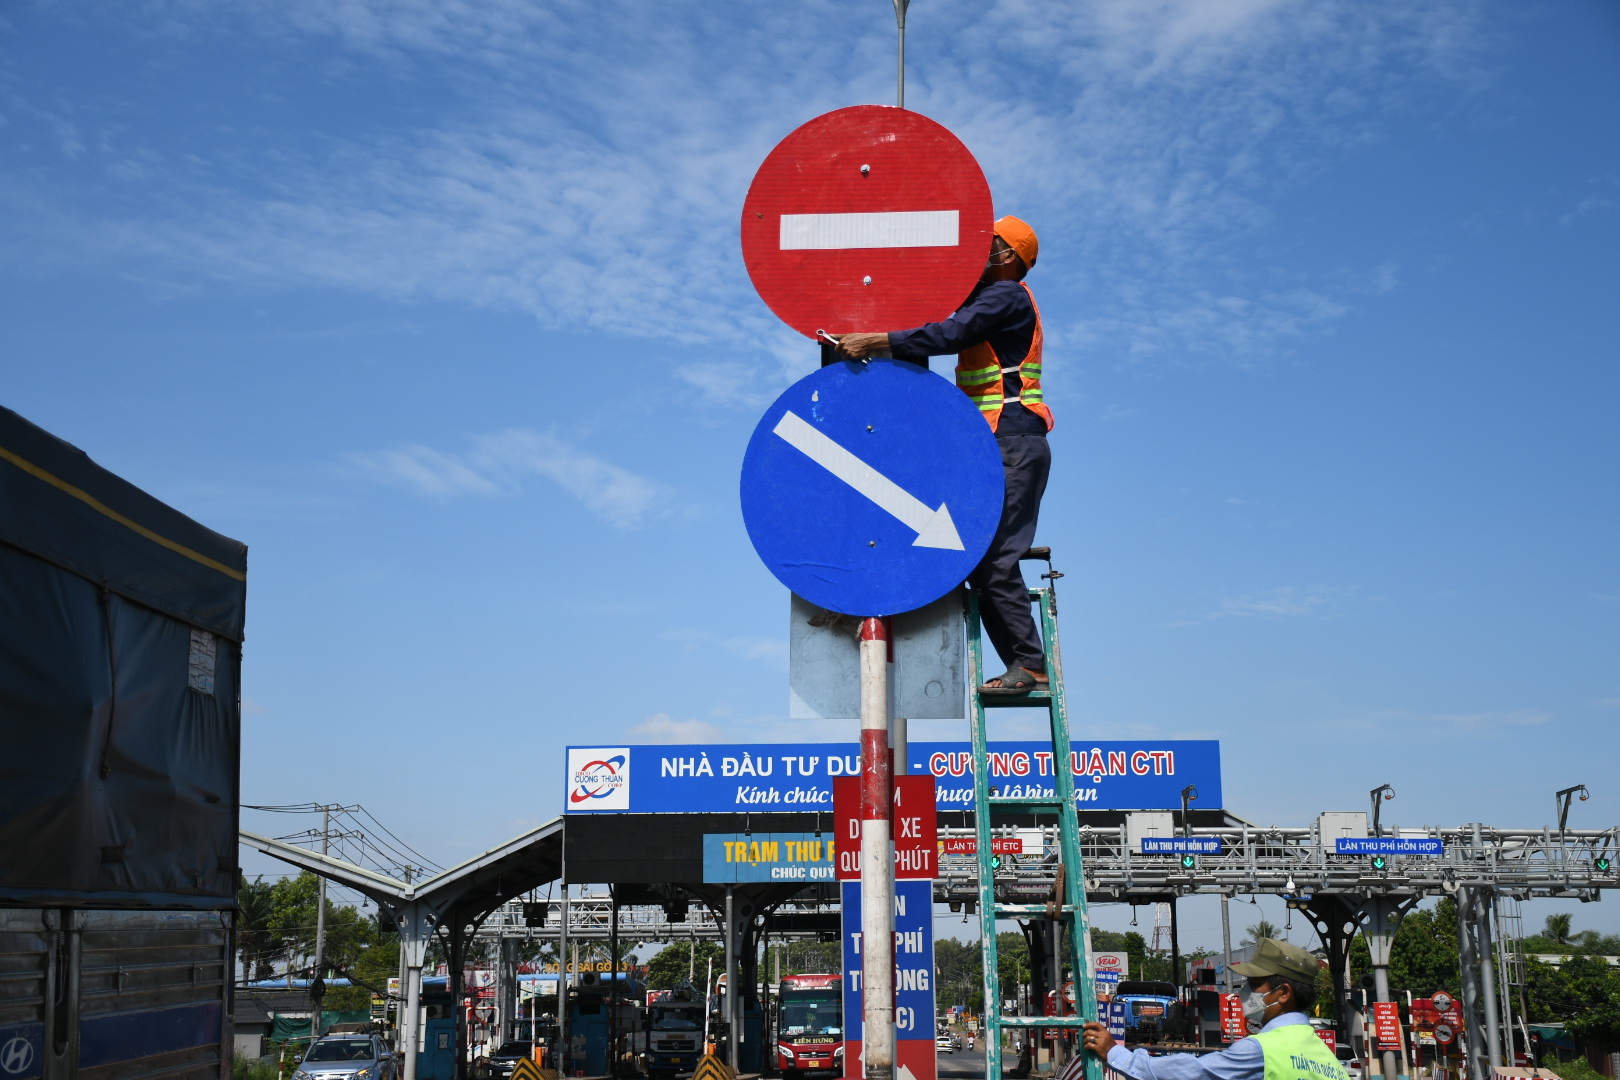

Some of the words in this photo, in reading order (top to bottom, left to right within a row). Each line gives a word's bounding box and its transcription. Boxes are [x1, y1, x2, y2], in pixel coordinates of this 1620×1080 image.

[661, 752, 713, 777] NHÀ
[721, 751, 773, 777] ĐẦU
[782, 756, 819, 776] TƯ
[929, 751, 1030, 777] CƯNG
[1130, 750, 1175, 776] CTI
[735, 785, 780, 804] Kính
[784, 785, 829, 804] chúc
[900, 817, 922, 838] XE
[1003, 842, 1019, 850] ETC
[1144, 840, 1159, 851] LÀN
[1159, 841, 1173, 851] THU
[1174, 840, 1186, 851] PHÍ
[1339, 840, 1357, 851] LÀN
[1360, 842, 1378, 851] THU
[1380, 840, 1395, 852] PHÍ
[1396, 840, 1416, 852] HỖN
[1418, 842, 1438, 854] HỢP
[724, 841, 778, 867] TRẠM
[785, 841, 821, 862] THU
[771, 864, 806, 879] CHÚC
[545, 961, 573, 973] ĐÔG
